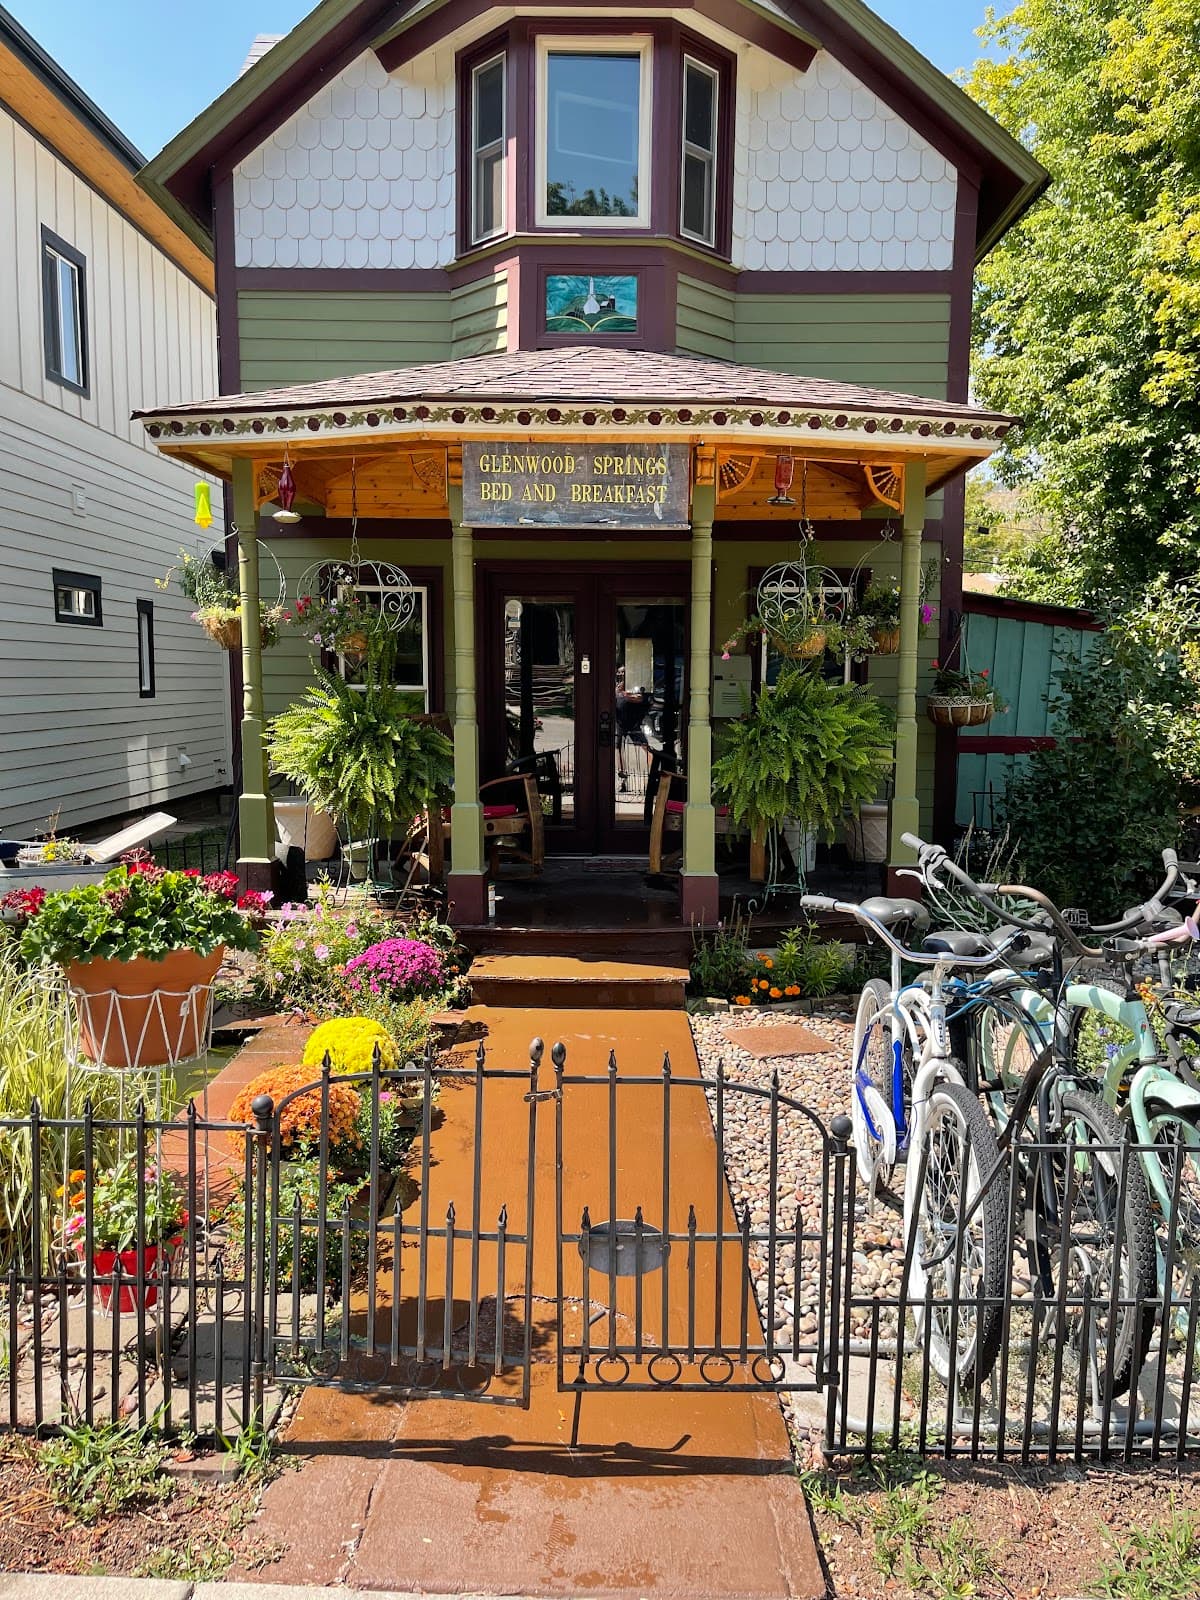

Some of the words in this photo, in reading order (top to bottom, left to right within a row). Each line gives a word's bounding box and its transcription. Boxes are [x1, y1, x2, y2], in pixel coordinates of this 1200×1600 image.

[479, 454, 575, 474] GLENWOOD
[593, 455, 667, 475] SPRINGS
[480, 482, 512, 501] BED
[522, 483, 556, 502] AND
[571, 484, 667, 503] BREAKFAST
